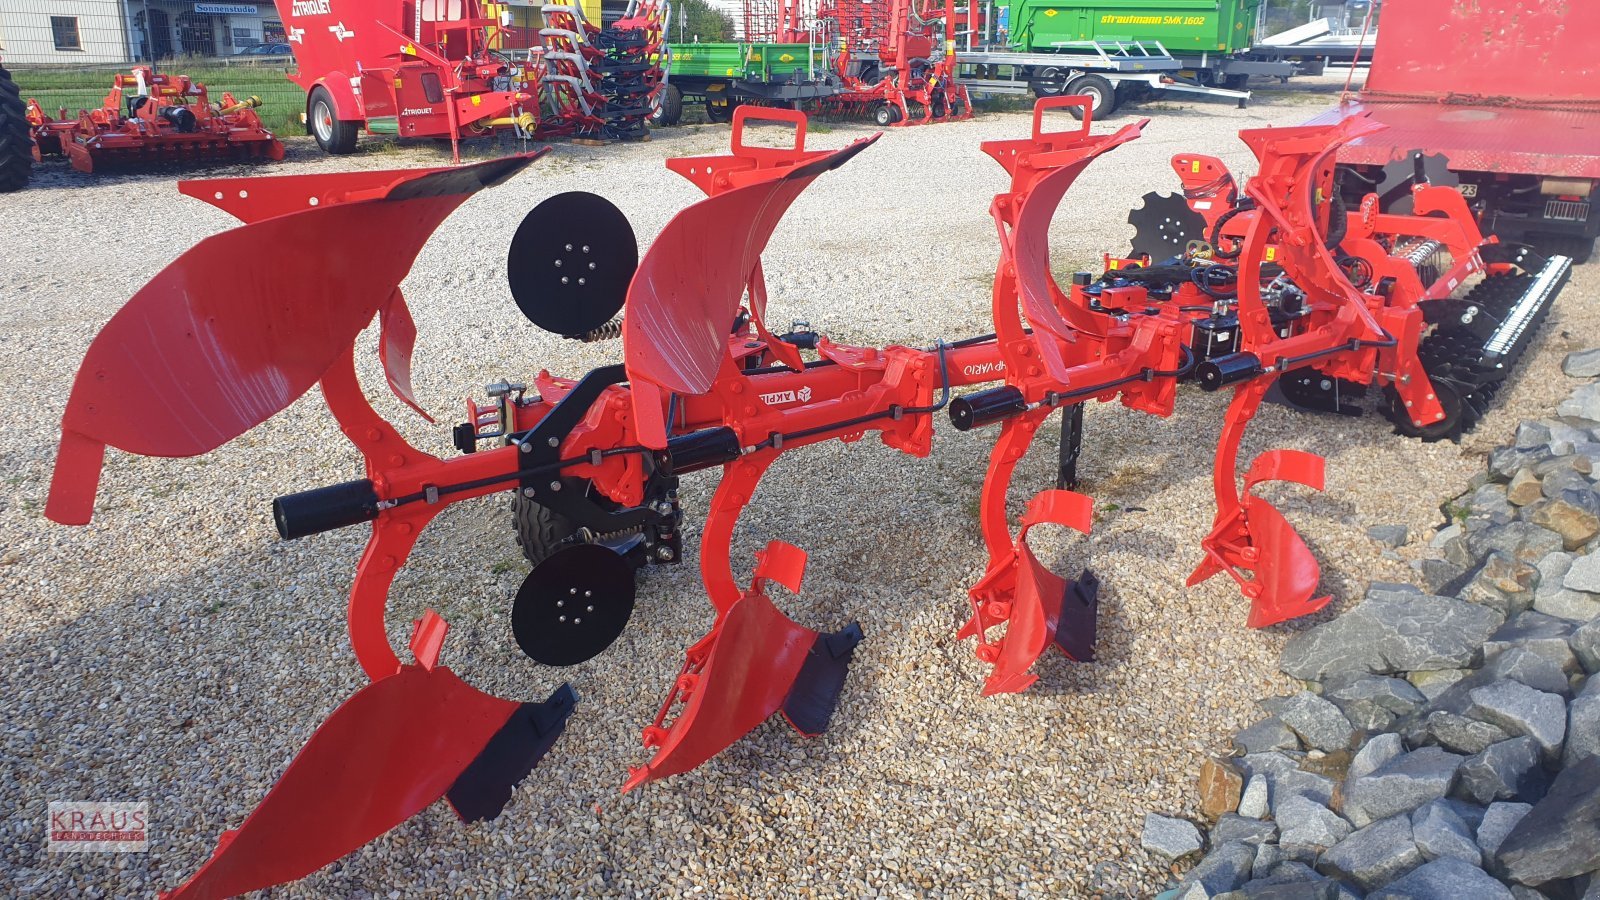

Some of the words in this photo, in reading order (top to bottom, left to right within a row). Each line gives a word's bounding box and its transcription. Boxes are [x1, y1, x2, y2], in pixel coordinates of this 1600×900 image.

[196, 3, 256, 13] Sonnenstudio
[1100, 14, 1163, 24] strautmann
[1163, 16, 1183, 25] SMK
[1183, 16, 1206, 25] 1602
[1461, 185, 1477, 196] 23
[963, 362, 994, 376] VARIO
